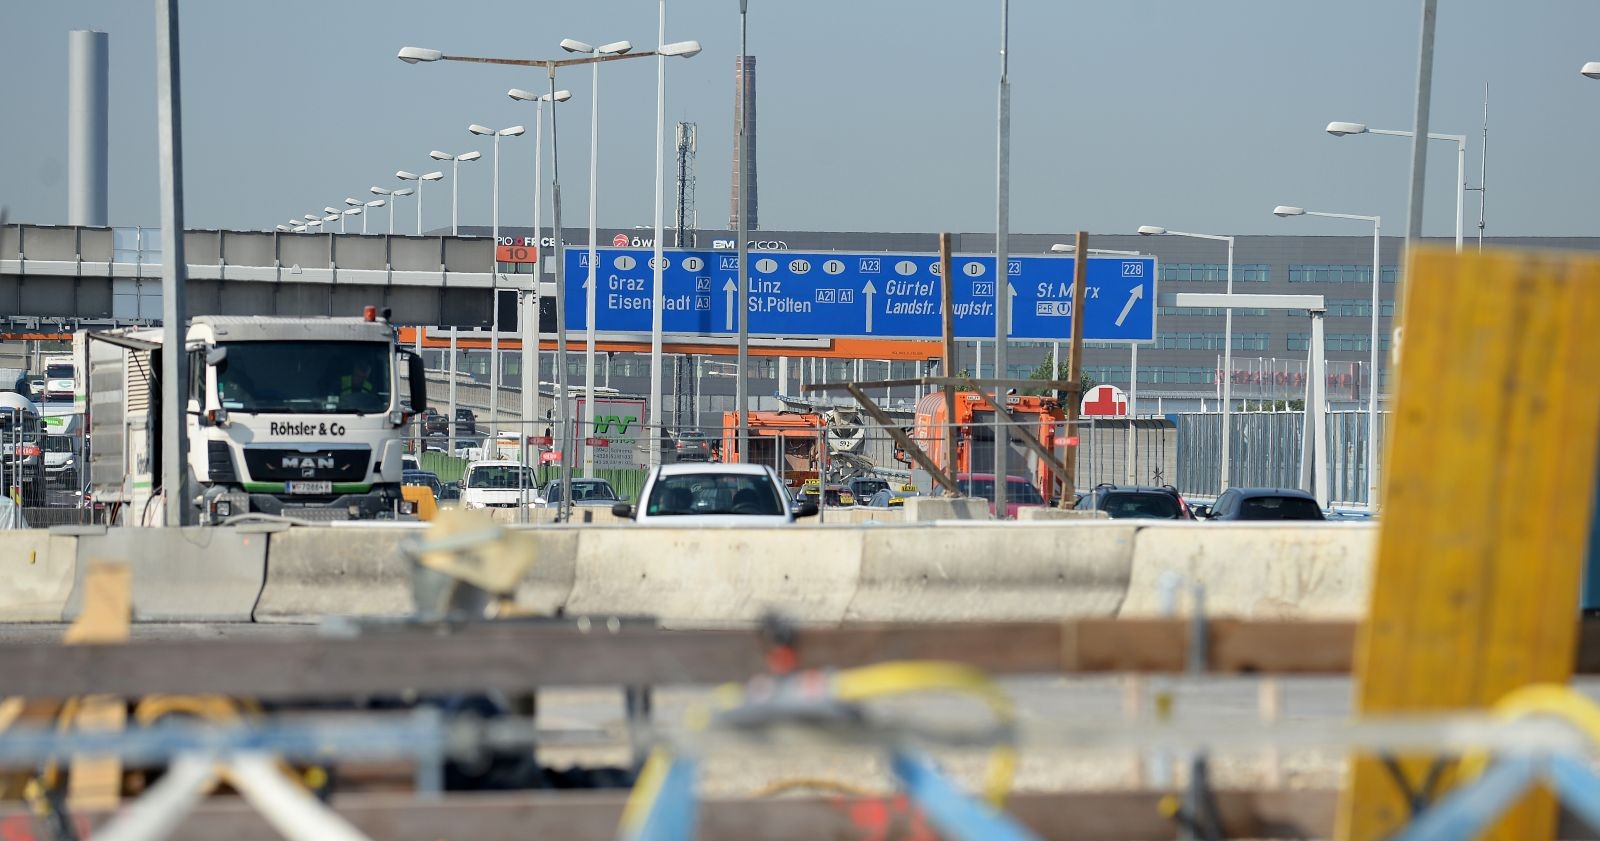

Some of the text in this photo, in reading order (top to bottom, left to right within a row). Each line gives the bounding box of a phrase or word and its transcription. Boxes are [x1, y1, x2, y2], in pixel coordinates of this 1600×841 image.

[631, 236, 656, 248] ÖW
[505, 247, 528, 260] 10
[690, 259, 697, 270] D
[721, 257, 739, 269] A23
[791, 262, 809, 272] SLO
[830, 262, 837, 273] D
[860, 260, 879, 271] A23
[932, 264, 942, 274] SL
[971, 264, 978, 275] D
[1123, 264, 1142, 275] 228
[609, 274, 645, 291] Graz
[697, 278, 710, 290] A2
[748, 277, 781, 294] Linz
[885, 280, 935, 296] Gürtel
[975, 283, 992, 295] 221
[1058, 282, 1100, 299] Mrx
[608, 293, 691, 311] Eisentadt
[818, 290, 851, 302] A21 A1
[696, 297, 709, 309] A3
[885, 299, 994, 319] Landstr. uptstr.
[270, 421, 346, 436] Röhsler & Co
[282, 457, 335, 469] MAN
